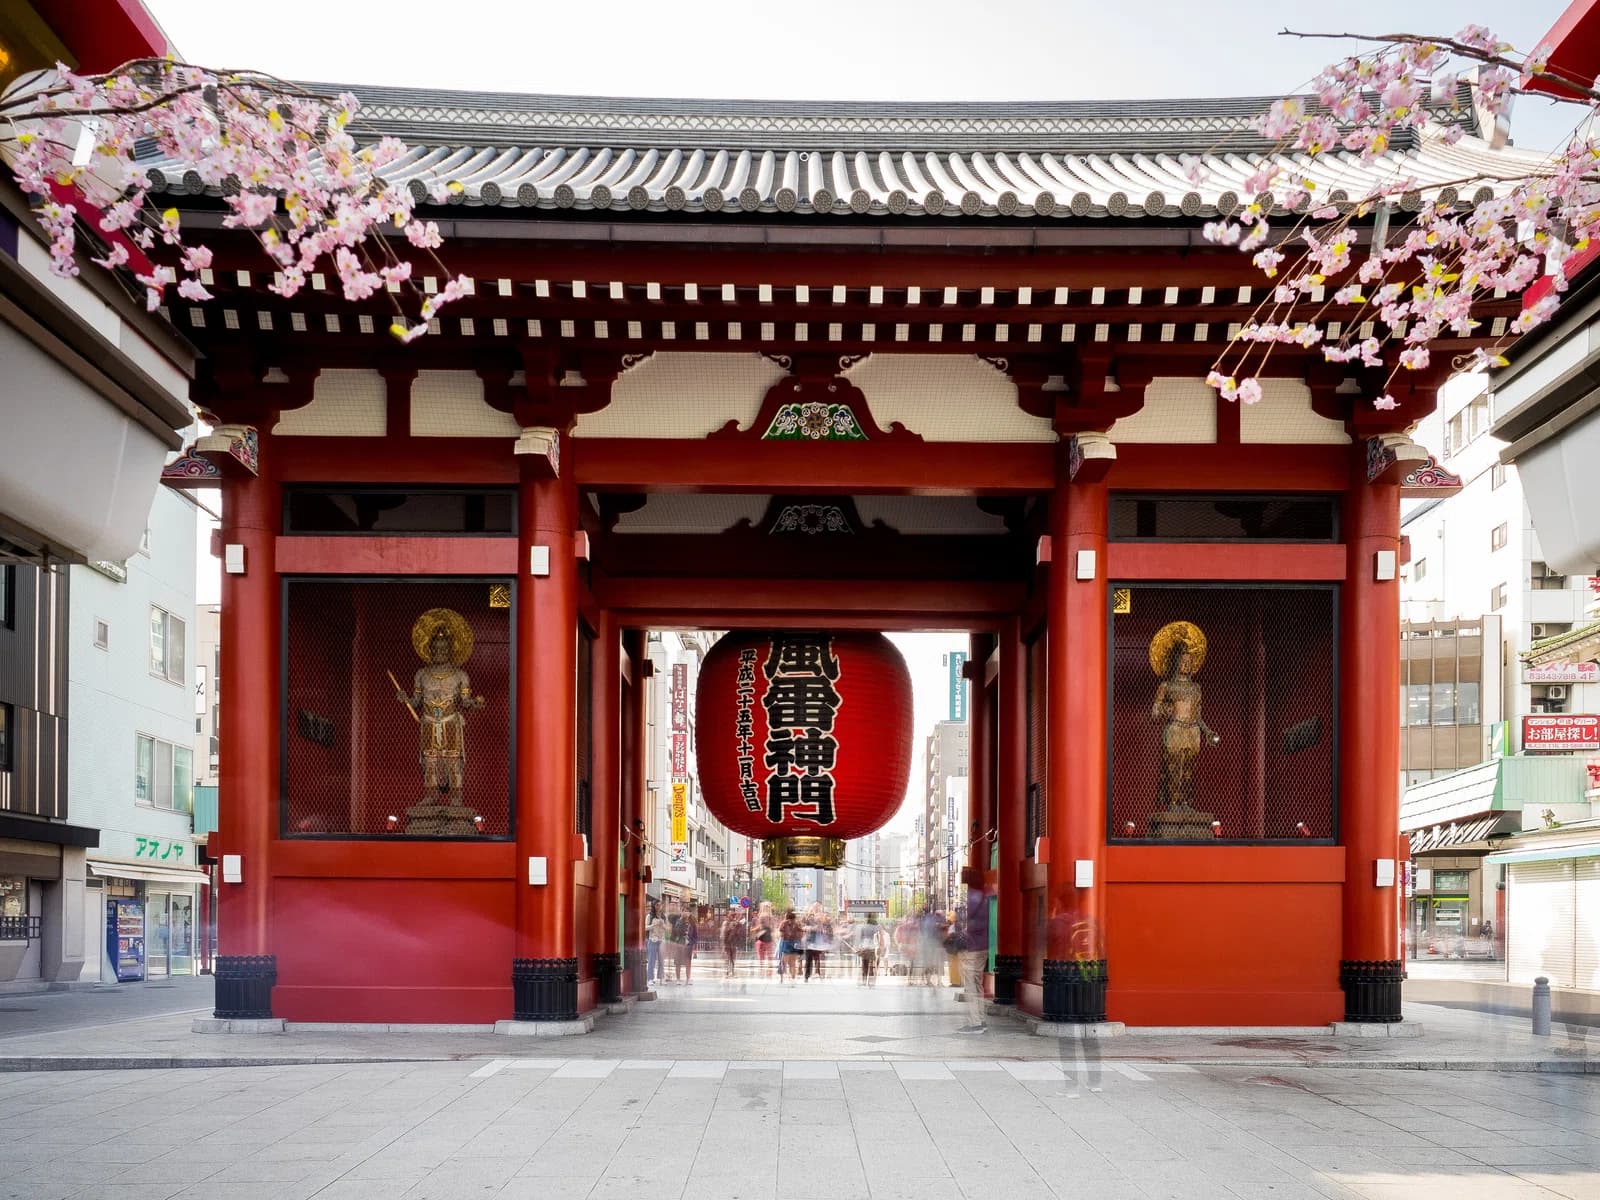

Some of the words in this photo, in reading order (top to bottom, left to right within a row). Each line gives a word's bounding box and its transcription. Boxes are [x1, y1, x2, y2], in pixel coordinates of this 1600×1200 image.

[736, 648, 763, 812] 平成二十五年十一月吉日
[761, 634, 843, 826] 風雷神門
[135, 837, 184, 861] アオノヤ
